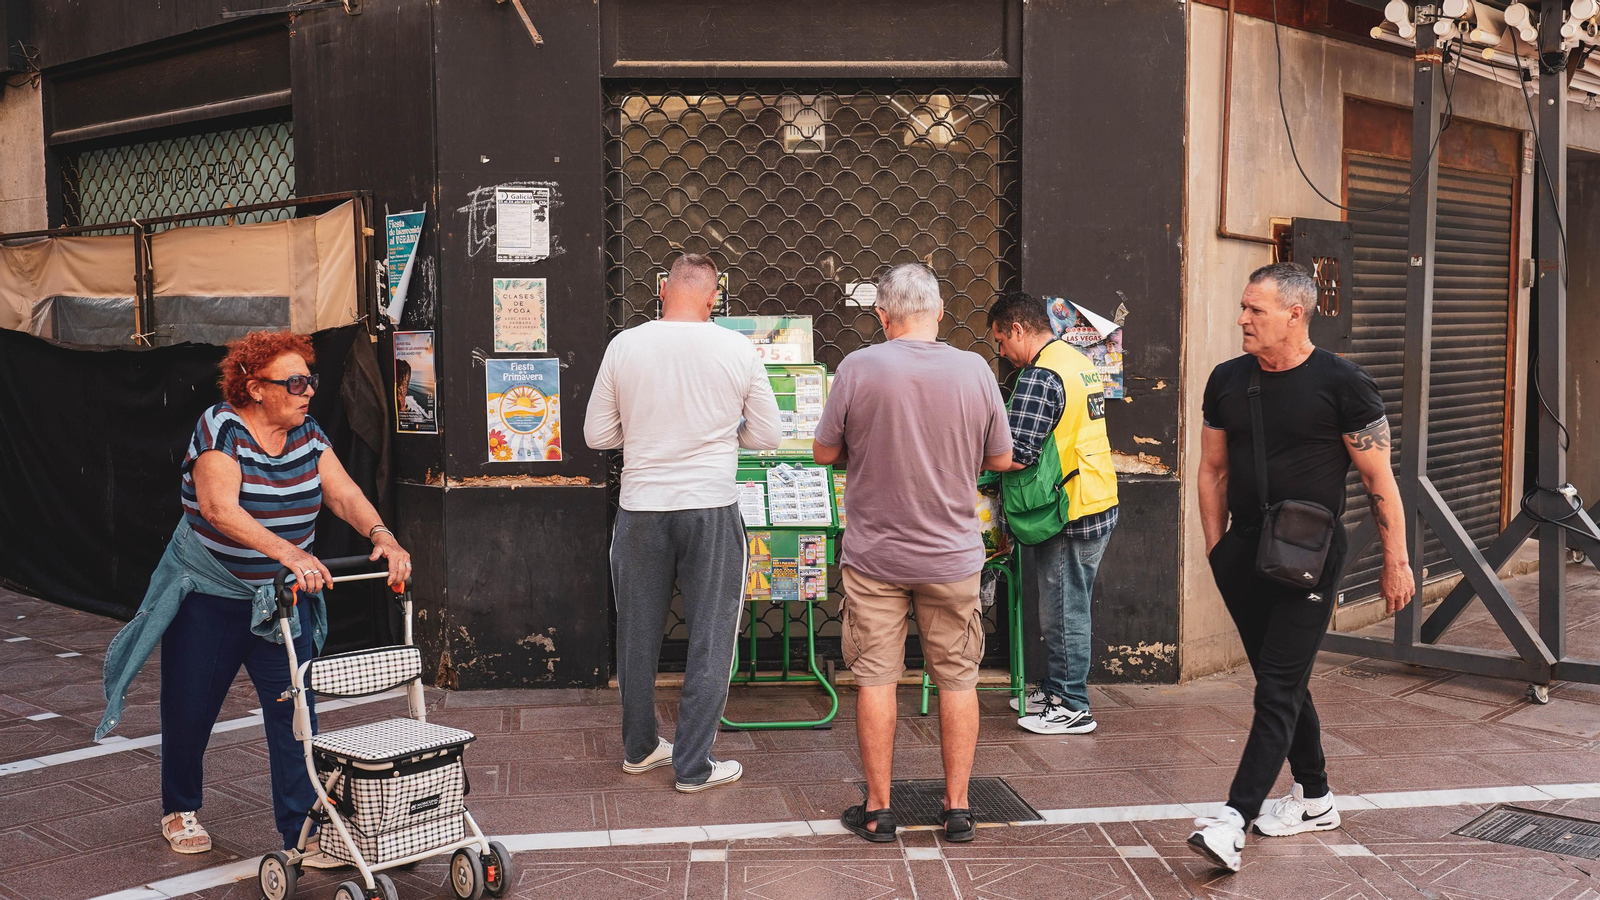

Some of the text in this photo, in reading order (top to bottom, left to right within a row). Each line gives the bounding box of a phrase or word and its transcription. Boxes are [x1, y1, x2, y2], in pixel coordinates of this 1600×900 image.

[137, 160, 248, 194] EDIFICIO REAL
[389, 220, 405, 228] Fiesta
[510, 362, 535, 370] Fiesta
[503, 373, 544, 381] Primavera
